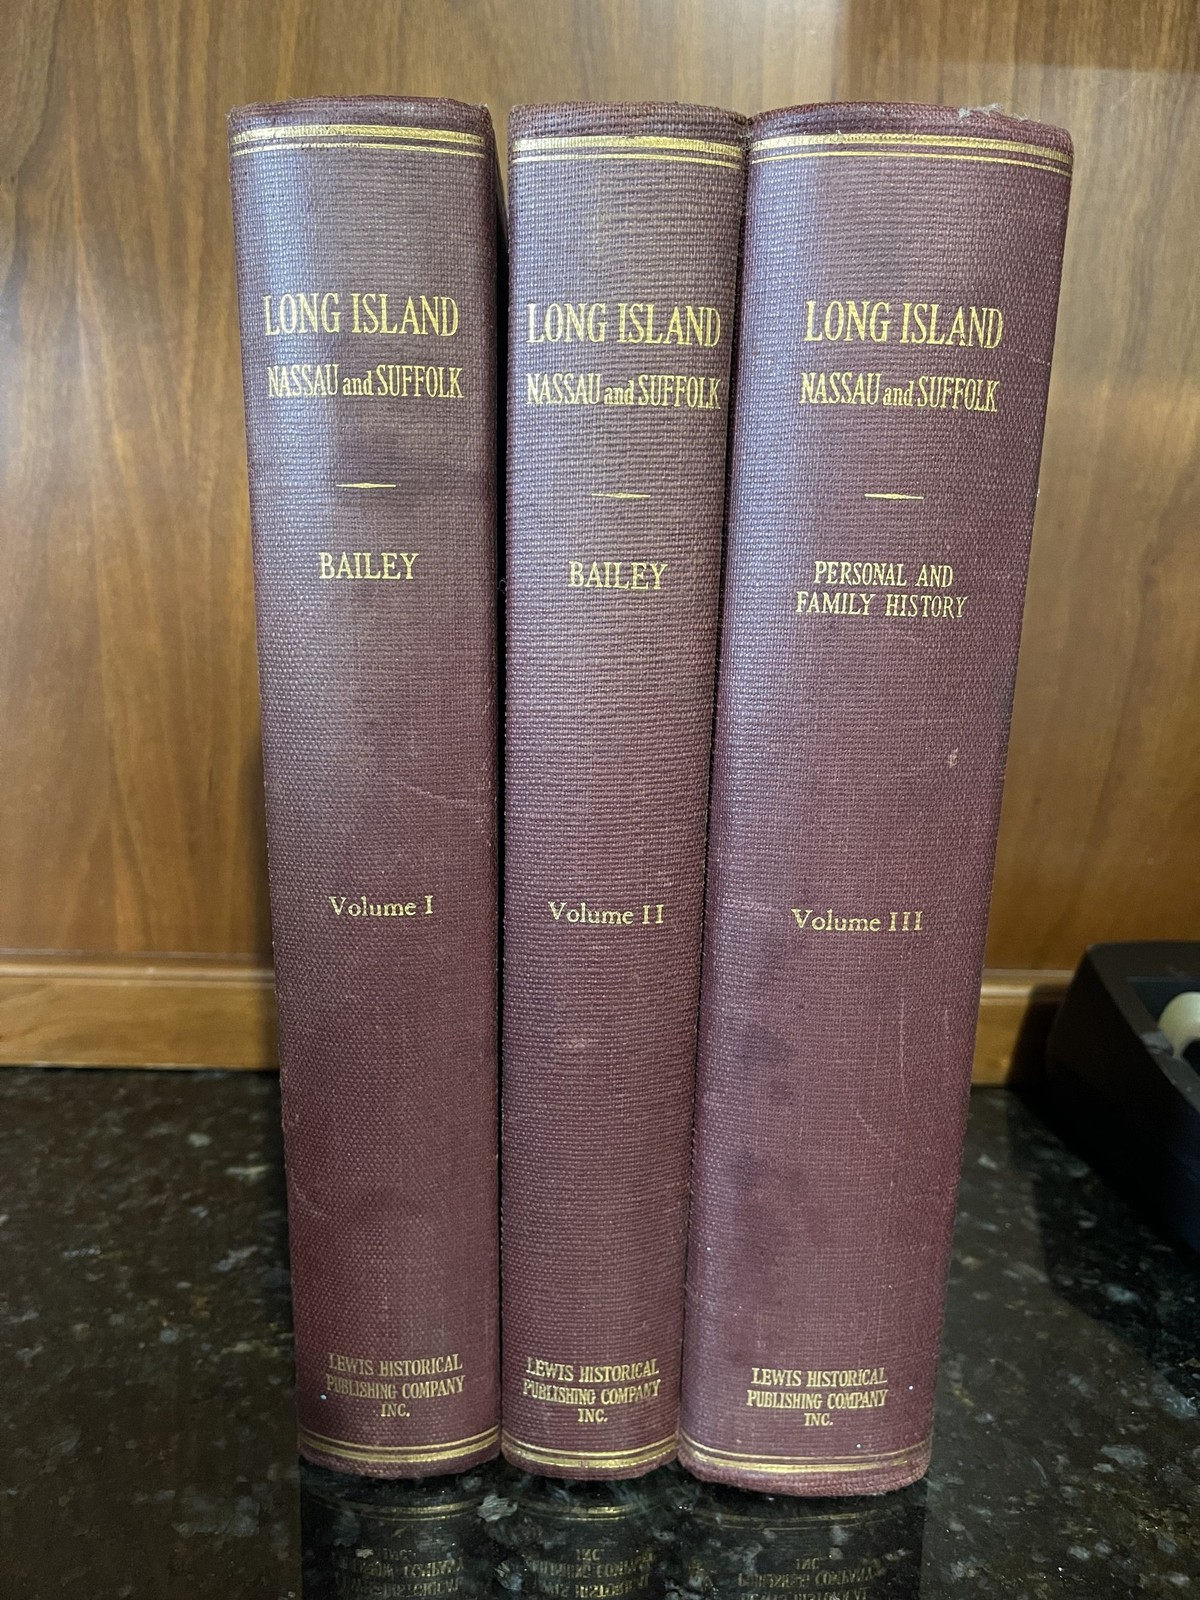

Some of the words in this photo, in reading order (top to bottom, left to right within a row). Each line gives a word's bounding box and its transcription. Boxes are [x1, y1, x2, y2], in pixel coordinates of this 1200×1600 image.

[264, 293, 341, 336] LONG
[351, 294, 459, 337] ISLAND
[526, 303, 606, 344] LONG
[617, 303, 721, 347] ISLAND
[804, 300, 890, 343] LONG
[900, 302, 1004, 349] ISLAND
[267, 363, 339, 398] NASSAU
[342, 369, 373, 396] and
[377, 366, 464, 399] SUFFOLK
[526, 372, 601, 406] NASSAU
[604, 379, 634, 406] and
[638, 374, 721, 410] SUFFOLK
[800, 372, 882, 405] NASSAU
[883, 381, 914, 407] and
[917, 376, 1000, 412] SUFFOLK
[319, 552, 419, 581] BAILEY
[568, 560, 668, 590] BAILEY
[814, 560, 907, 586] PERSONAL
[916, 564, 953, 588] AND
[795, 591, 875, 616] FAMILY
[885, 594, 968, 618] HISTORY
[329, 896, 417, 918] Volume
[424, 895, 434, 915] I
[548, 901, 634, 925] Volume
[642, 903, 664, 925] II
[791, 908, 882, 933] Volume
[887, 909, 923, 932] III
[327, 1352, 374, 1376] LEWIS
[379, 1353, 463, 1377] HISTORICAL
[525, 1357, 574, 1382] LEWIS
[579, 1358, 660, 1383] HISTORICAL
[751, 1367, 802, 1387] LEWIS
[806, 1367, 888, 1388] HISTORICAL
[325, 1373, 397, 1400] PUBLISHING
[402, 1374, 466, 1399] COMPANY
[523, 1378, 597, 1406] PUBLISHING
[601, 1379, 662, 1406] COMPANY
[746, 1389, 823, 1410] PUBLISHING
[827, 1388, 889, 1410] COMPANY
[380, 1403, 411, 1417] INC.
[577, 1408, 608, 1423] INC.
[803, 1412, 834, 1427] INC.
